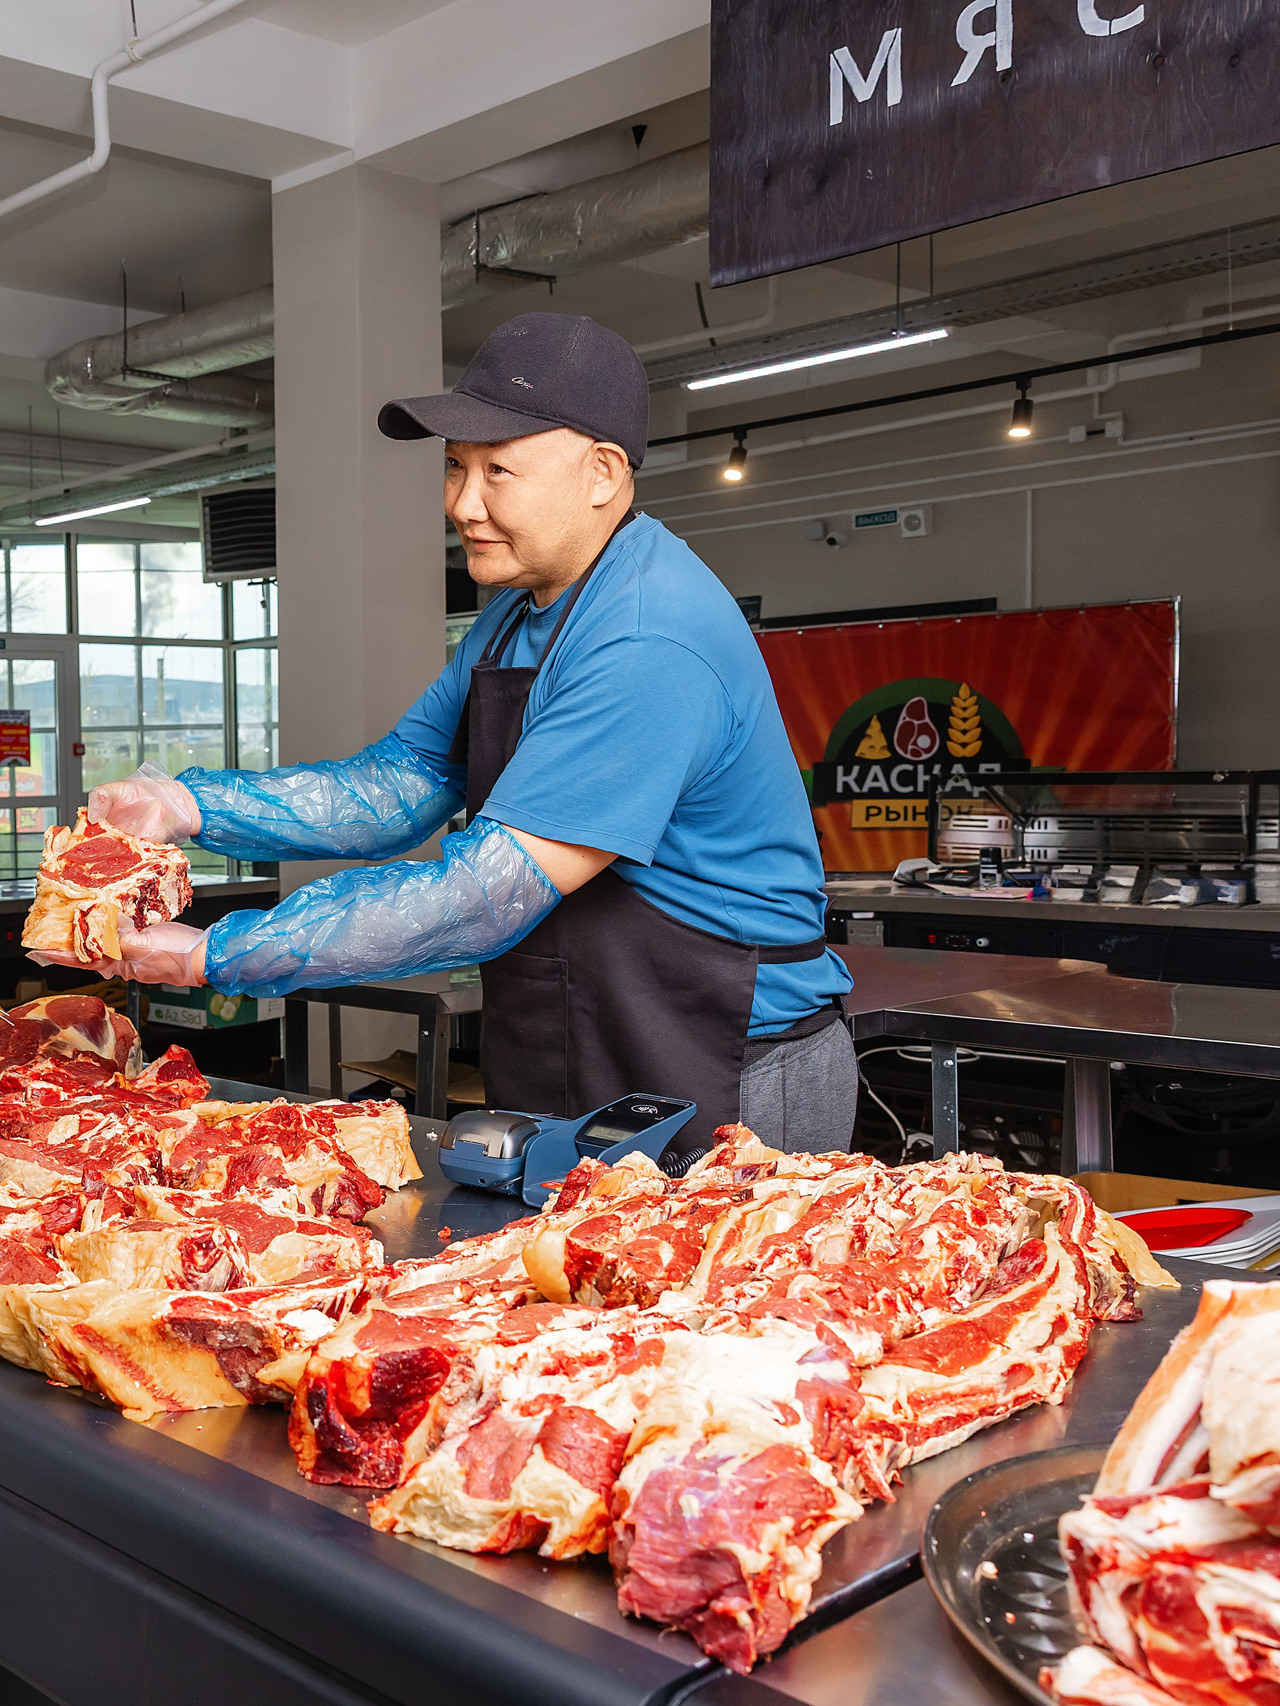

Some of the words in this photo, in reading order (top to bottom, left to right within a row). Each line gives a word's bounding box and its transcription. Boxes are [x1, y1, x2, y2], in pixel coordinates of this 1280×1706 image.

[857, 511, 896, 526] ВЫХОД
[165, 1008, 179, 1022] Az
[181, 1010, 202, 1026] Sad
